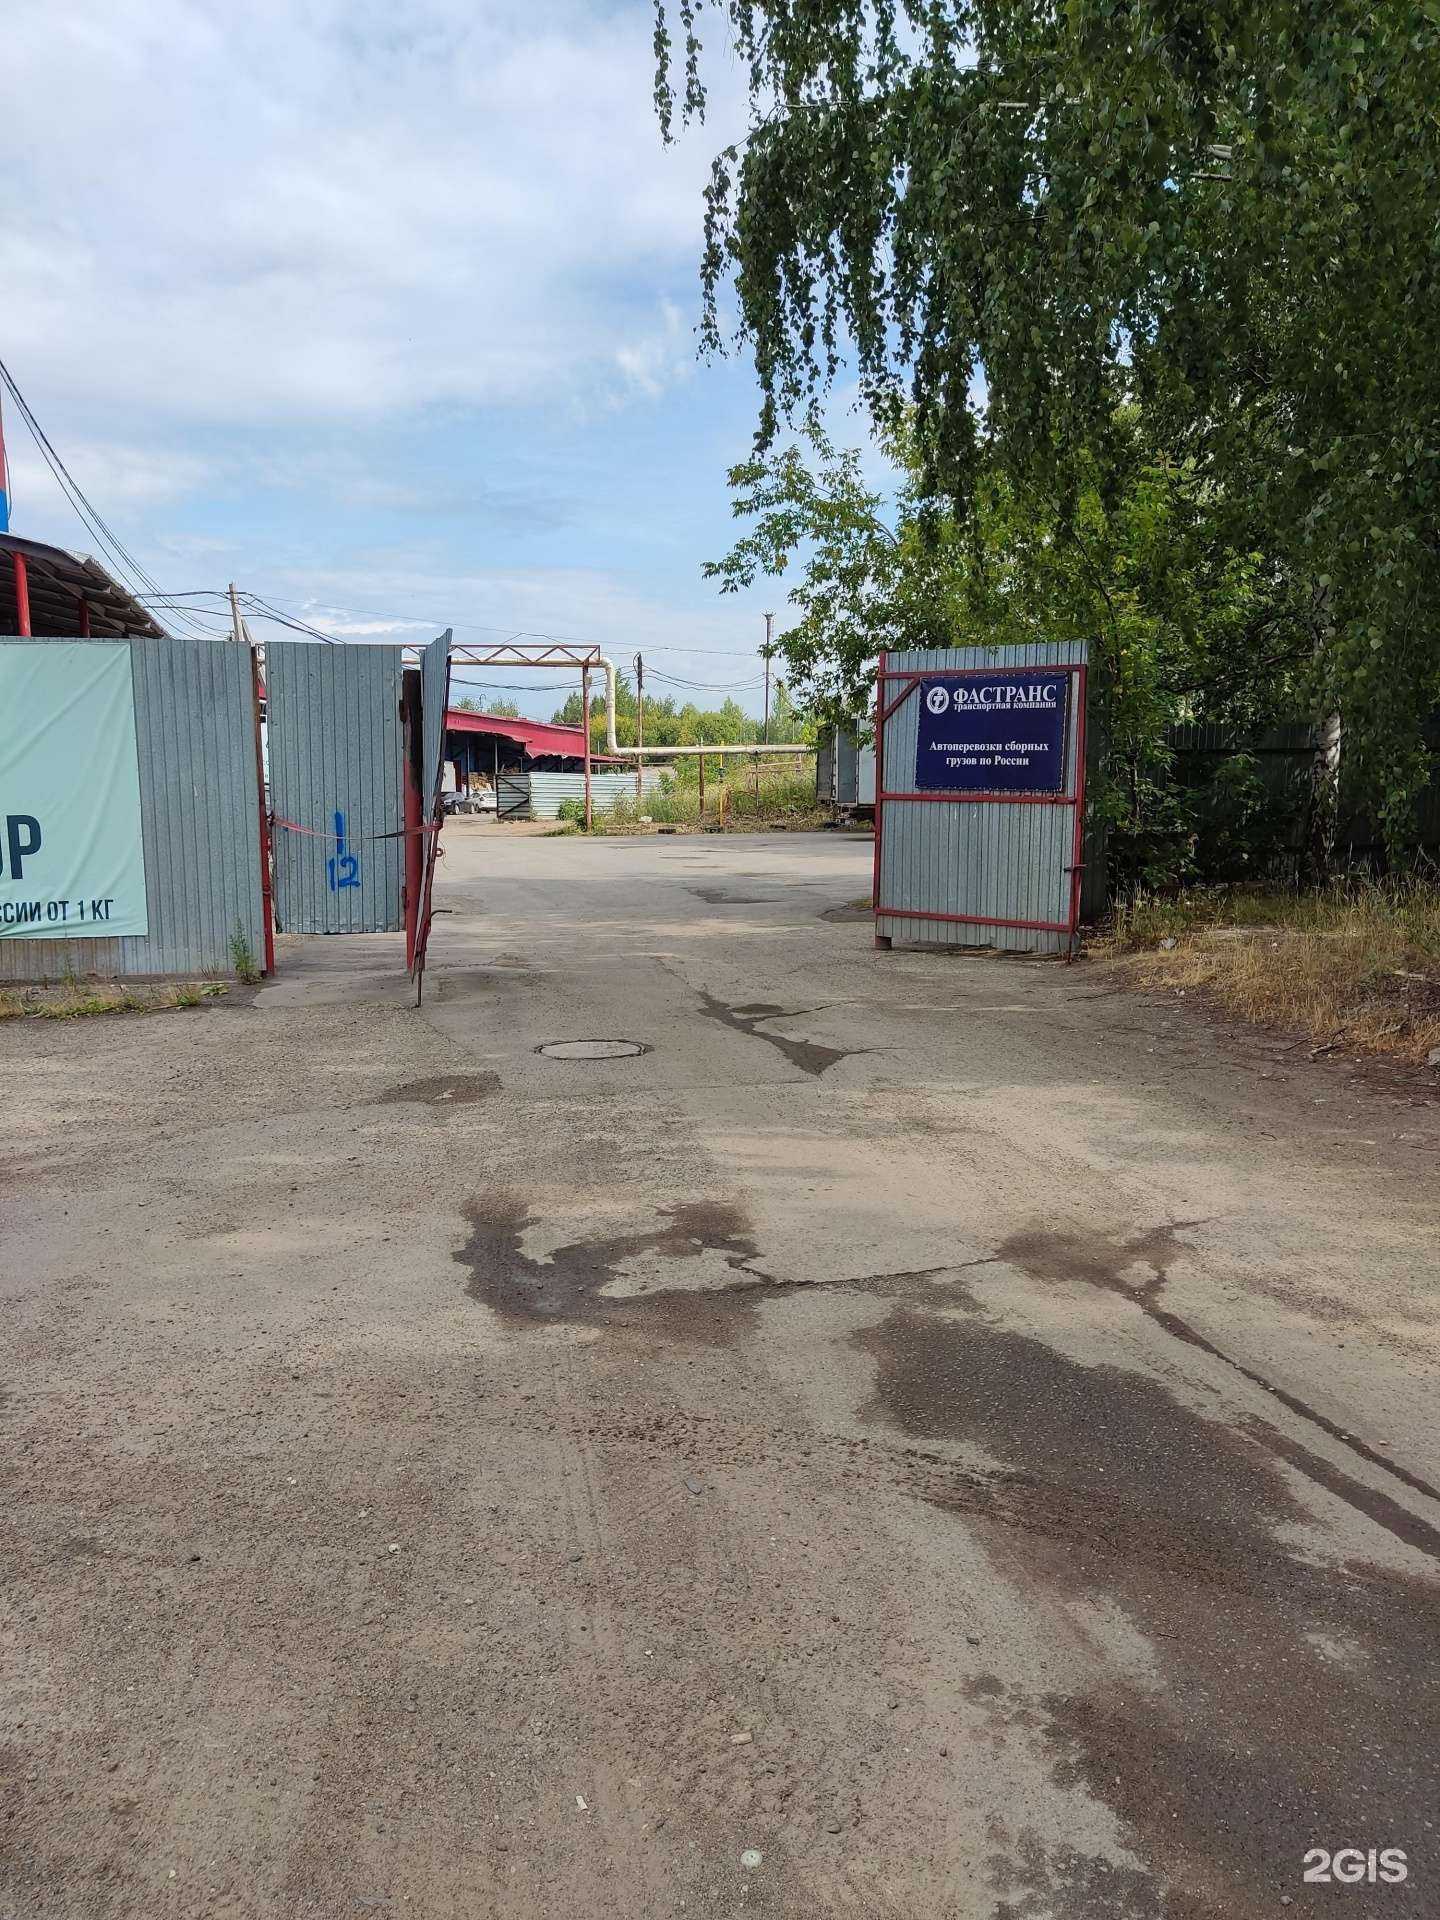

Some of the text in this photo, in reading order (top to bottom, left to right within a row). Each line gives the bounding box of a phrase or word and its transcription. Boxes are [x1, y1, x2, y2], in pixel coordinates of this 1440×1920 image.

[953, 684, 1057, 705] ФАСТРАНС
[953, 700, 1057, 712] транспортная компания
[929, 741, 1049, 754] Автоперевозки сборных
[945, 755, 1030, 767] грузов по России
[0, 815, 41, 880] Р
[329, 856, 361, 892] 12
[0, 899, 114, 923] СИИ ОТ 1 КГ
